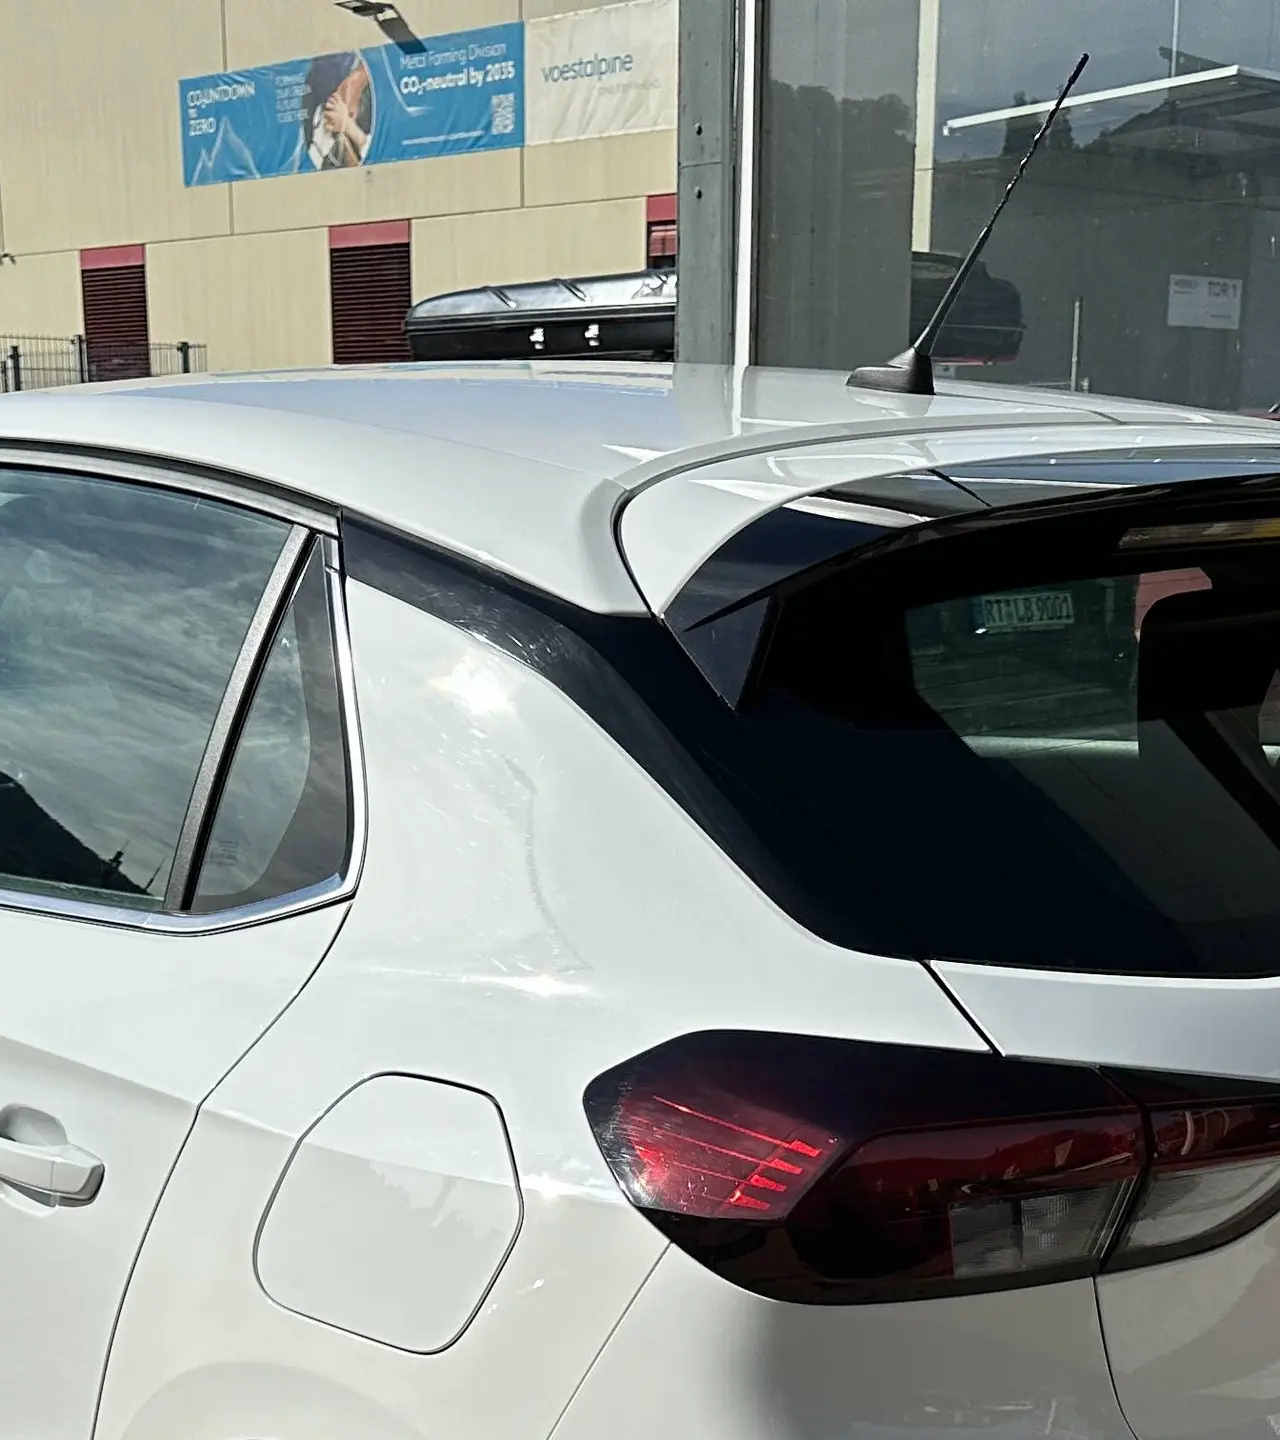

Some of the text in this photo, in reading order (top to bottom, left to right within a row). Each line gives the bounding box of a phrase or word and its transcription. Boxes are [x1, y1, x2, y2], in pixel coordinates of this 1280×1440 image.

[469, 67, 484, 87] by
[541, 52, 633, 83] voestalpine
[189, 118, 216, 136] ZERO
